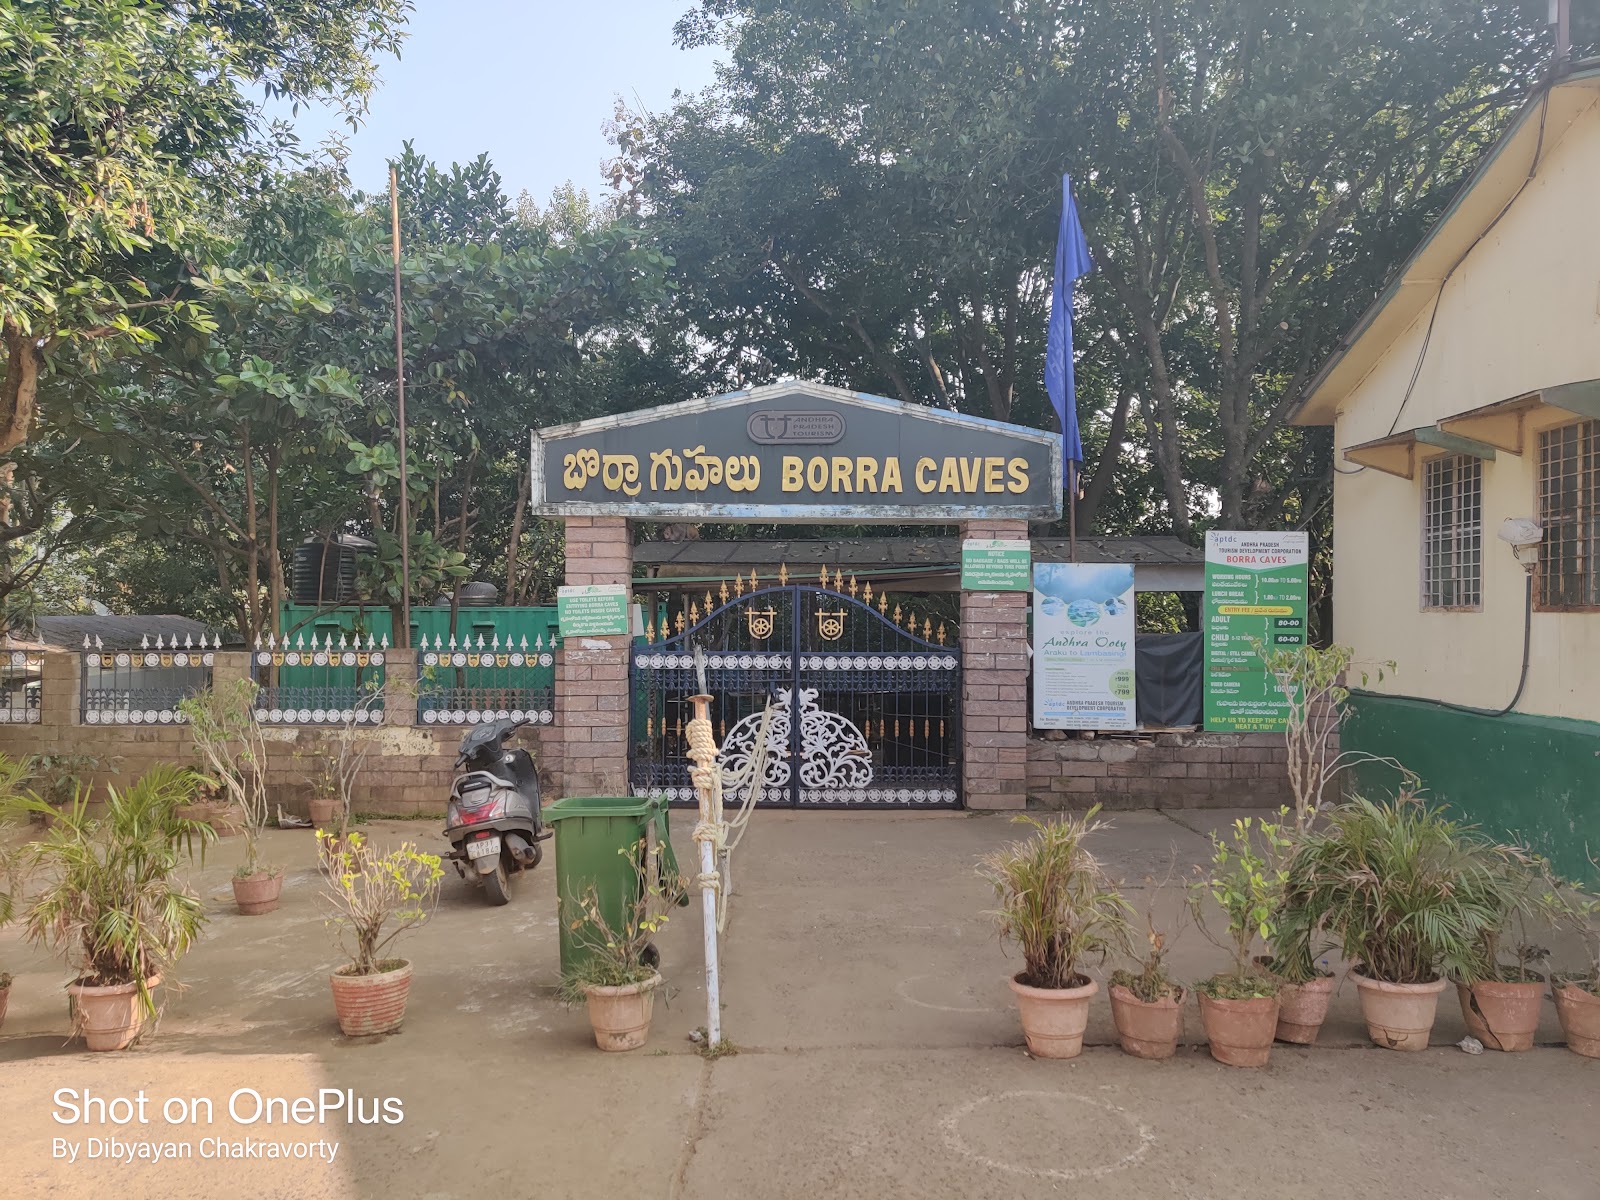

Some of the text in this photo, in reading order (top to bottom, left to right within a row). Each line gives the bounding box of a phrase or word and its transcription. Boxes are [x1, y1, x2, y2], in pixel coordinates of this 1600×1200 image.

[649, 445, 761, 492] గుహలు
[781, 456, 1029, 494] BORRA CAVES
[1260, 556, 1287, 564] CAVES
[1042, 637, 1127, 650] Andhra Ooty
